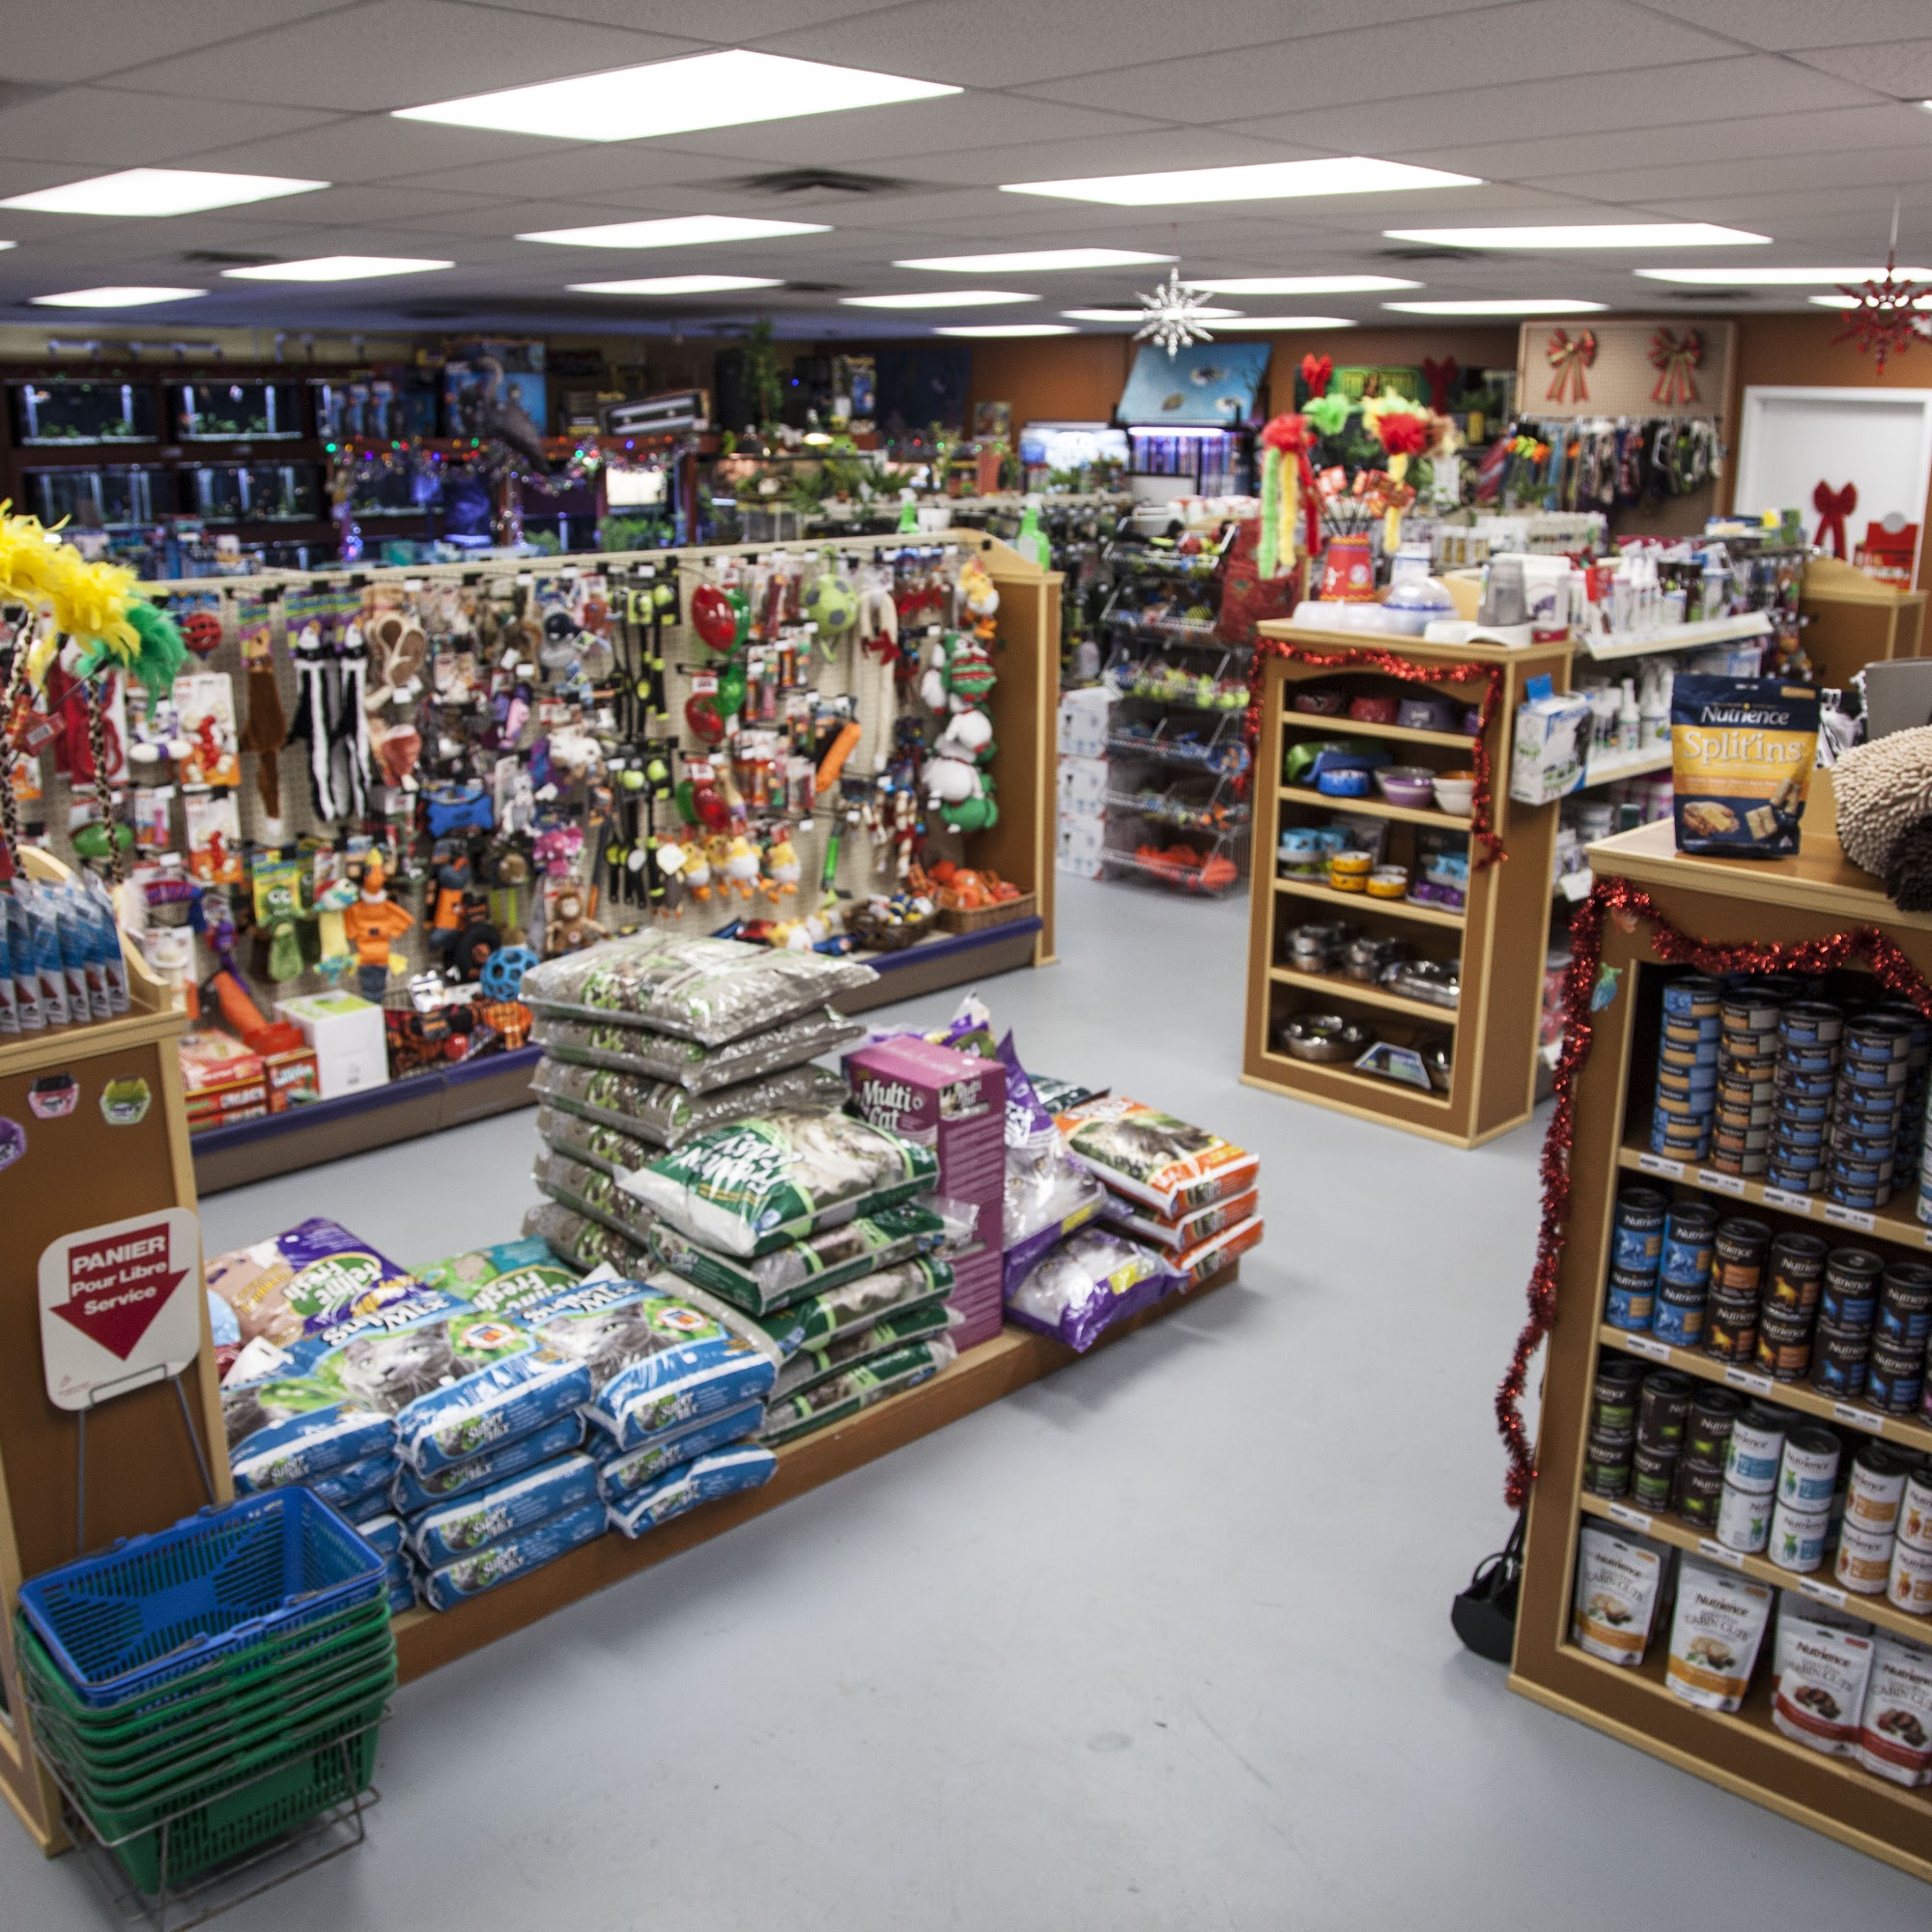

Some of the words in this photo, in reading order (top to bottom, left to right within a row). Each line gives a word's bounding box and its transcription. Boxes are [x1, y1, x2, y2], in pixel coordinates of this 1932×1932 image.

[1700, 706, 1790, 725] Nutrience
[1684, 731, 1804, 765] Split'ins
[861, 1080, 912, 1112] Multi
[869, 1108, 899, 1131] Cat
[72, 1236, 166, 1275] PANIER
[71, 1276, 116, 1298] Pour
[119, 1261, 167, 1284] Libre
[282, 1260, 345, 1301] Fresh
[314, 1263, 383, 1305] Feline
[470, 1271, 548, 1312] Fresh
[84, 1286, 157, 1316] Service
[1695, 1593, 1749, 1617] Nutrience
[1797, 1641, 1852, 1667] Nutrience
